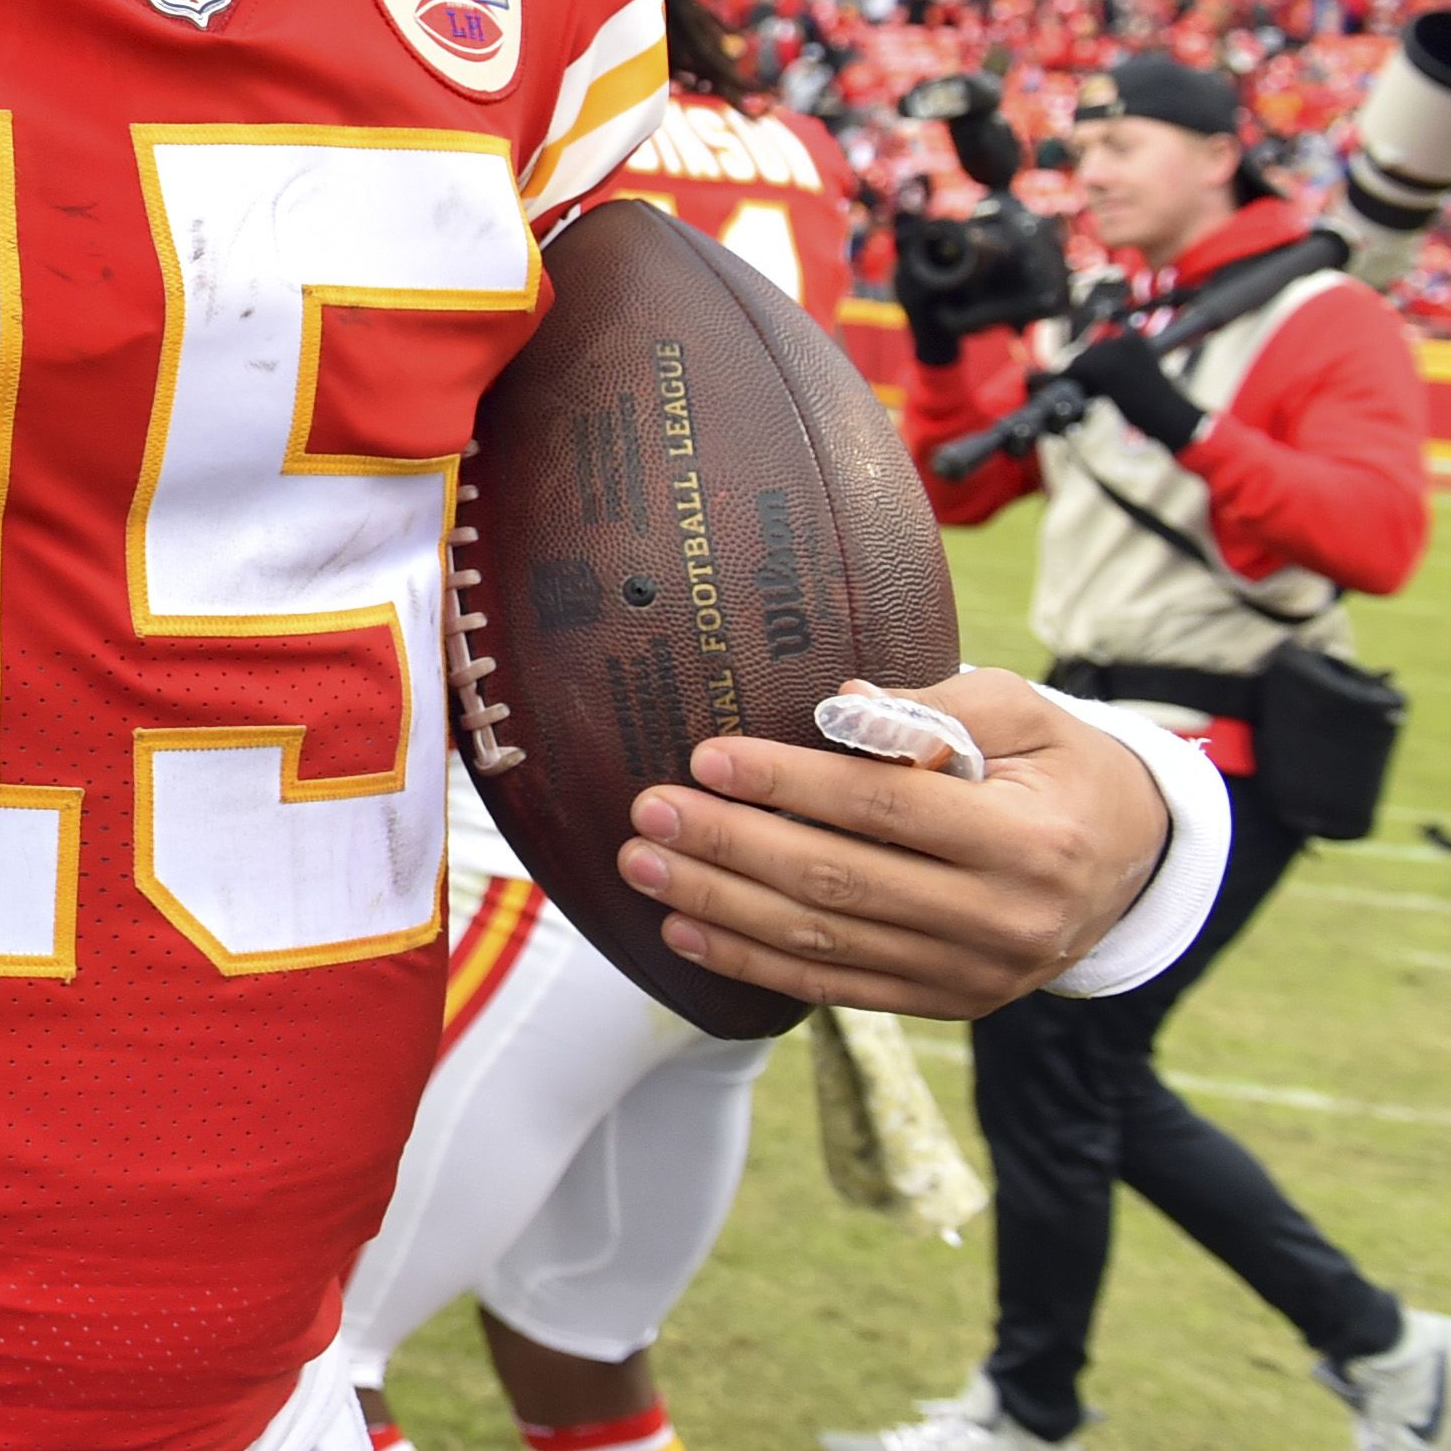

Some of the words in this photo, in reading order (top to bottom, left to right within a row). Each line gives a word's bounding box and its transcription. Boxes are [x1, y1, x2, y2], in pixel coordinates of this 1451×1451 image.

[445, 9, 485, 42] LH
[654, 341, 695, 457] LEAGUE
[674, 472, 727, 653] FOOTBALL
[753, 489, 812, 662] Wilson
